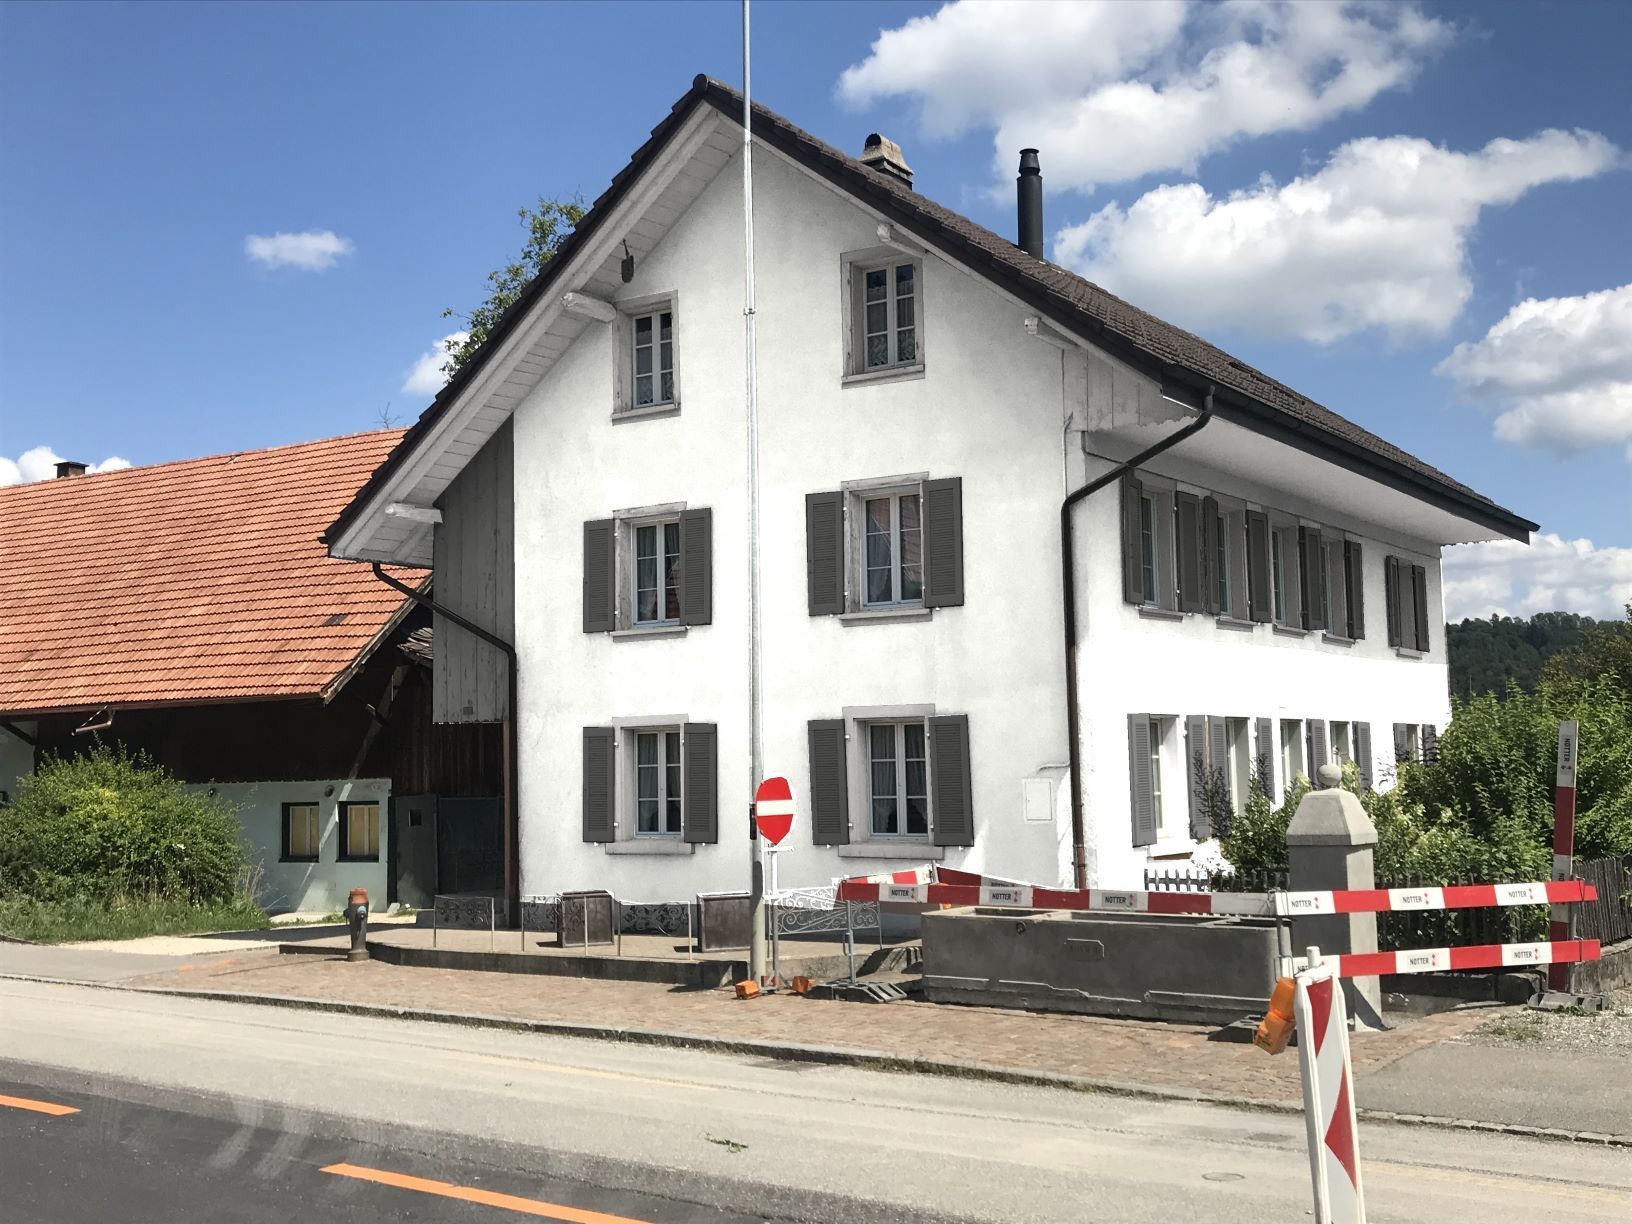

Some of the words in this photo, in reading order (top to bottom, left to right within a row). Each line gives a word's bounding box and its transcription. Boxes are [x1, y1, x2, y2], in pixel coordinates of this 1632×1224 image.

[891, 889, 909, 897] NOTTER
[1508, 890, 1527, 898] NOTTER
[1104, 896, 1127, 904] NOTTER
[1291, 900, 1312, 908] NOTTER
[1410, 957, 1429, 965] NOTTER
